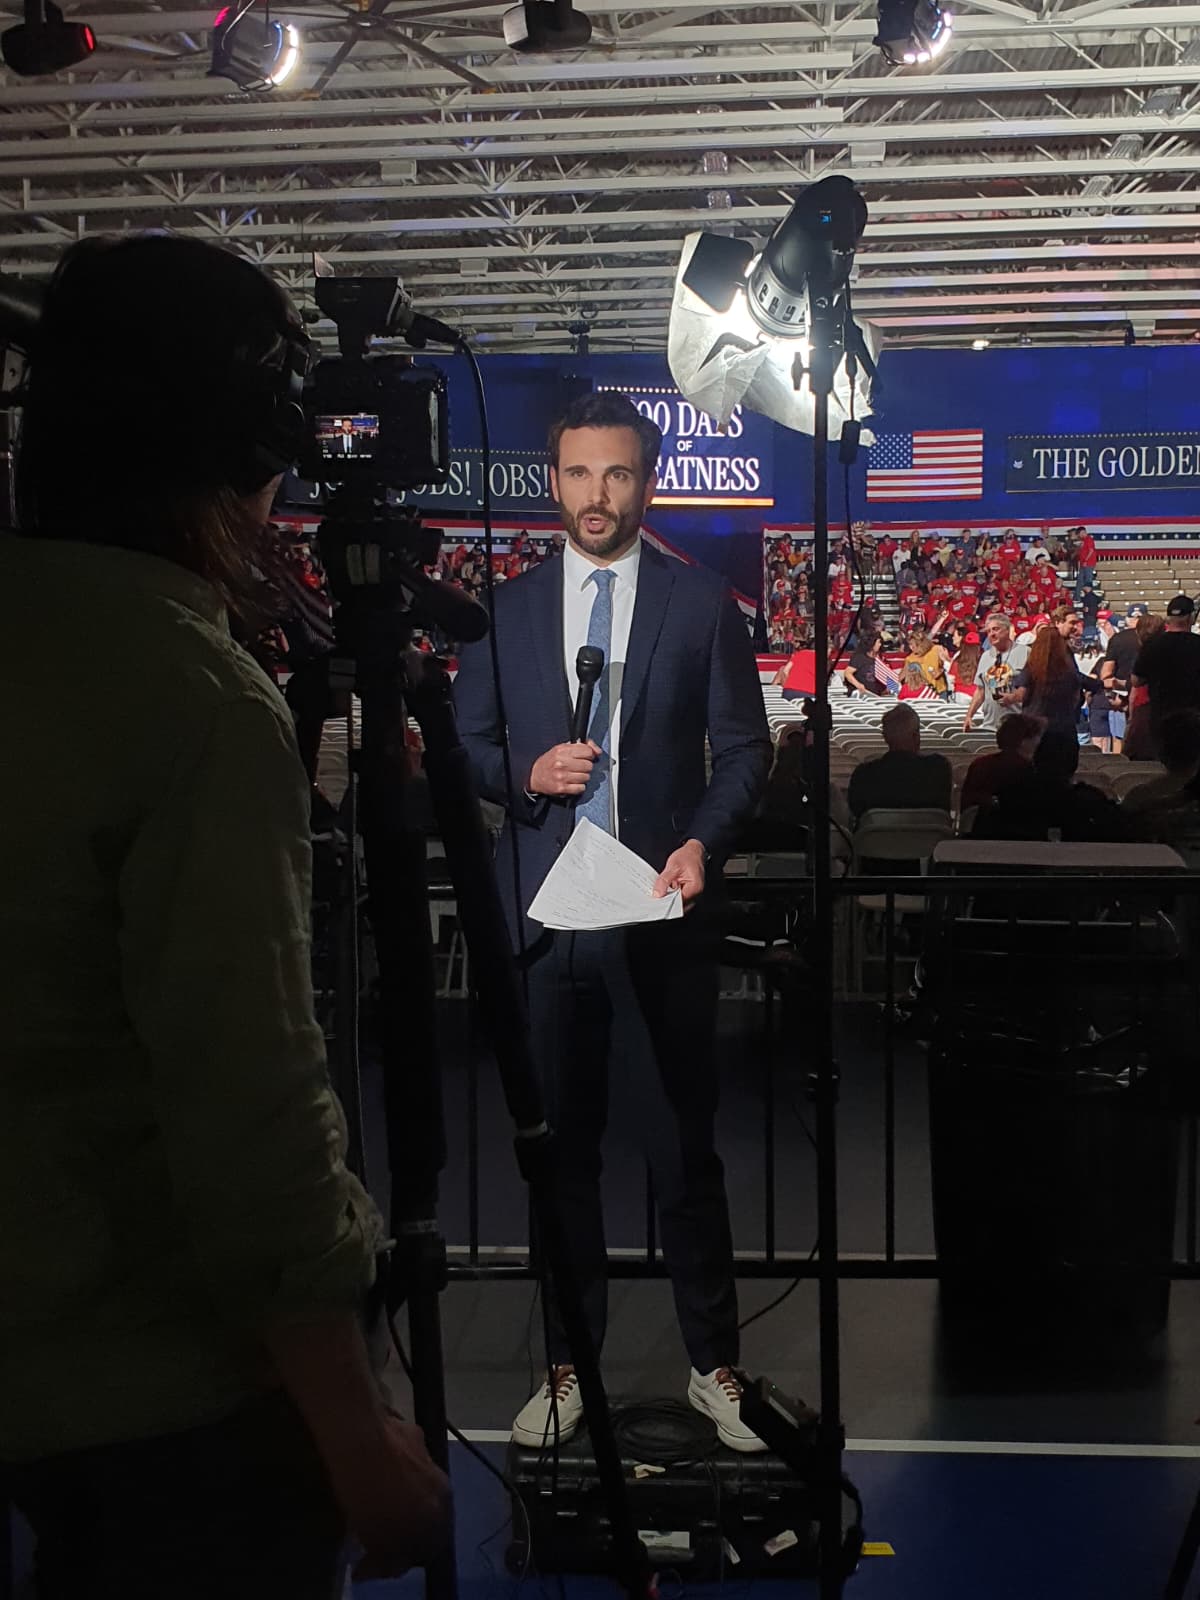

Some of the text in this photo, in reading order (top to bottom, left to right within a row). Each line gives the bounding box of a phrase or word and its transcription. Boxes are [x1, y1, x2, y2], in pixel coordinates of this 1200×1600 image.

[637, 400, 743, 437] 00 DAS
[676, 439, 693, 452] OF
[1033, 445, 1200, 479] THE GOLDE
[655, 455, 760, 491] ATNESS
